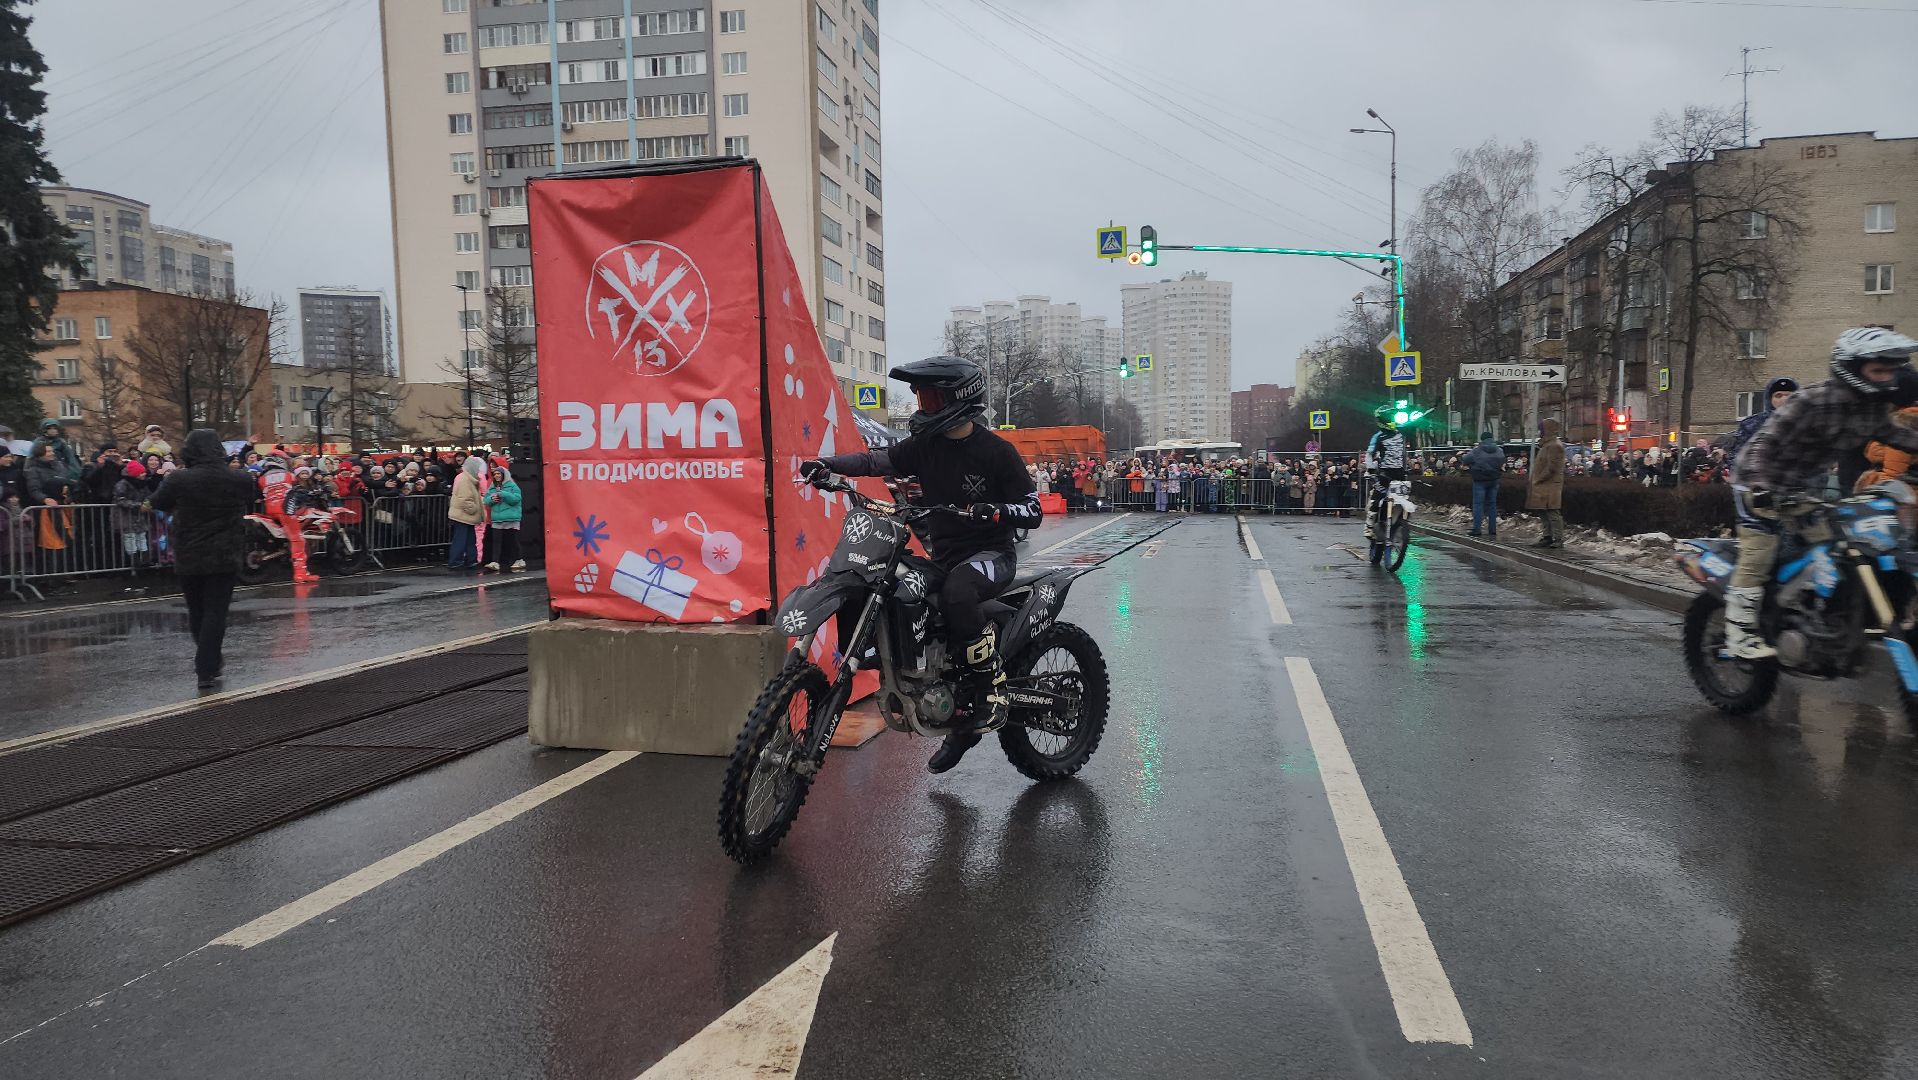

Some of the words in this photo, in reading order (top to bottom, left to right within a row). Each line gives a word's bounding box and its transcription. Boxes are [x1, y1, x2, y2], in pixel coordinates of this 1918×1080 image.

[1801, 145, 1838, 160] 1963
[558, 399, 743, 450] ЗИМА
[560, 464, 572, 480] В
[578, 461, 744, 483] ПОДМОСКОВЬЕ
